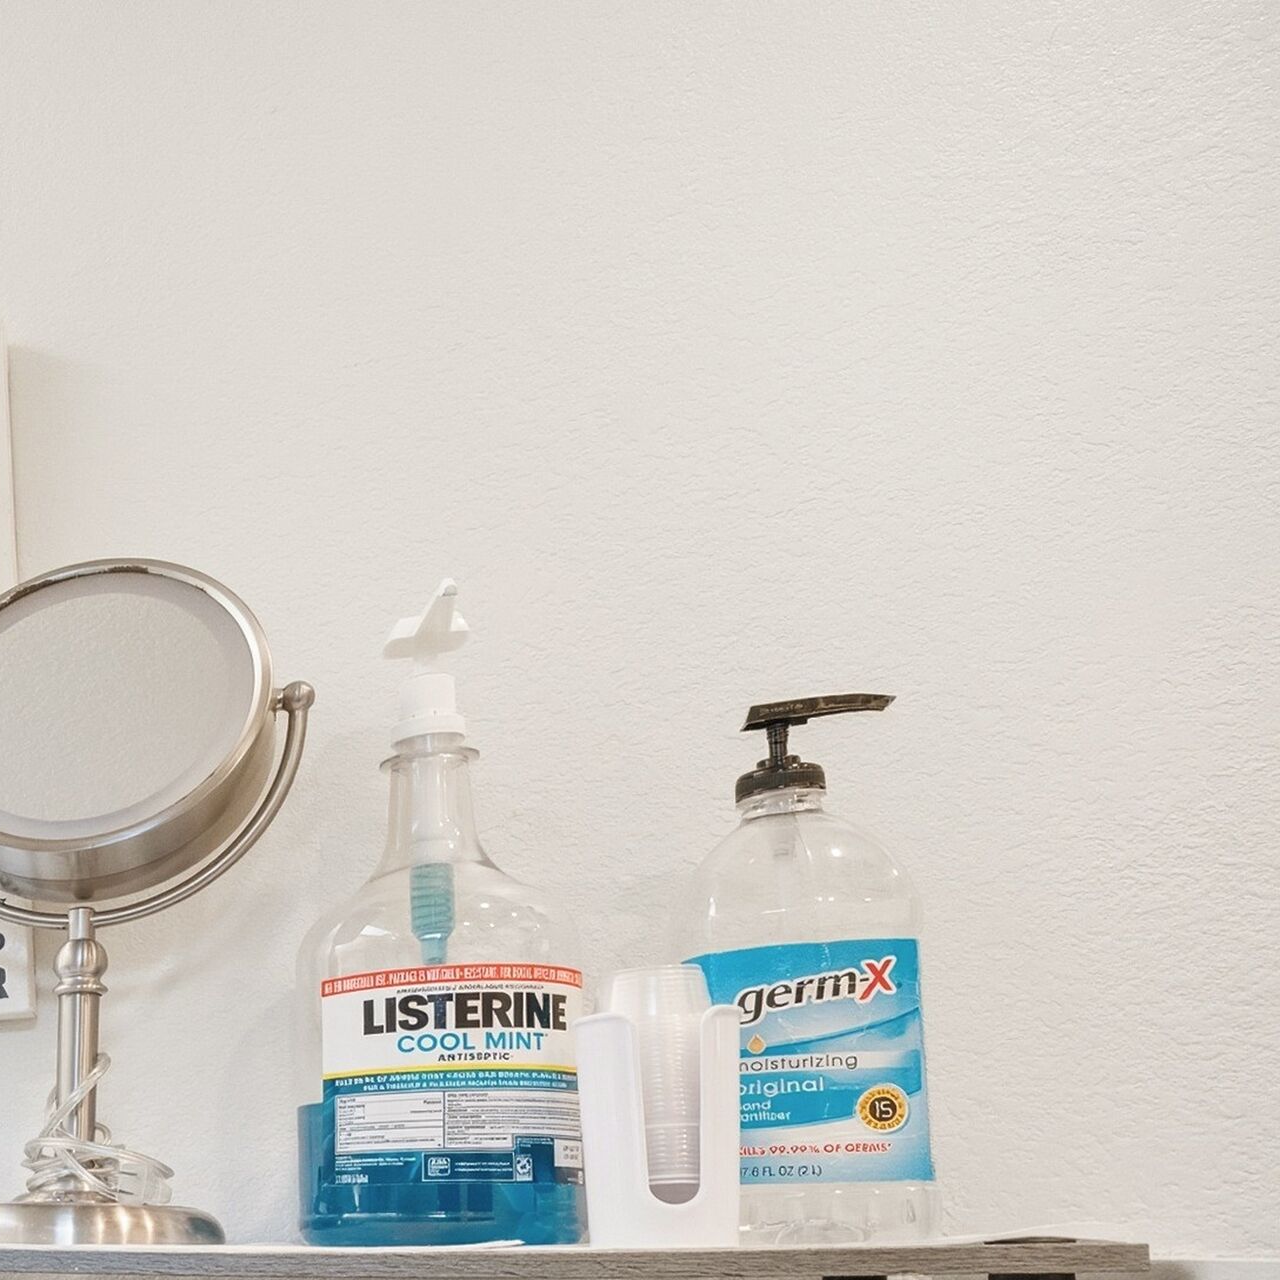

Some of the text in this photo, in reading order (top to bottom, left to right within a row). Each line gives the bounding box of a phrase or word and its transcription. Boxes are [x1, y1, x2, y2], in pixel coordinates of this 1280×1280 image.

[738, 958, 894, 1025] germ-X
[362, 991, 568, 1036] LISTERINE
[397, 1031, 545, 1053] COOL MINT
[741, 1101, 772, 1111] and
[874, 1101, 893, 1118] 15
[741, 1111, 791, 1122] anitizer
[824, 1143, 841, 1153] OF
[740, 1166, 759, 1178] 7.6
